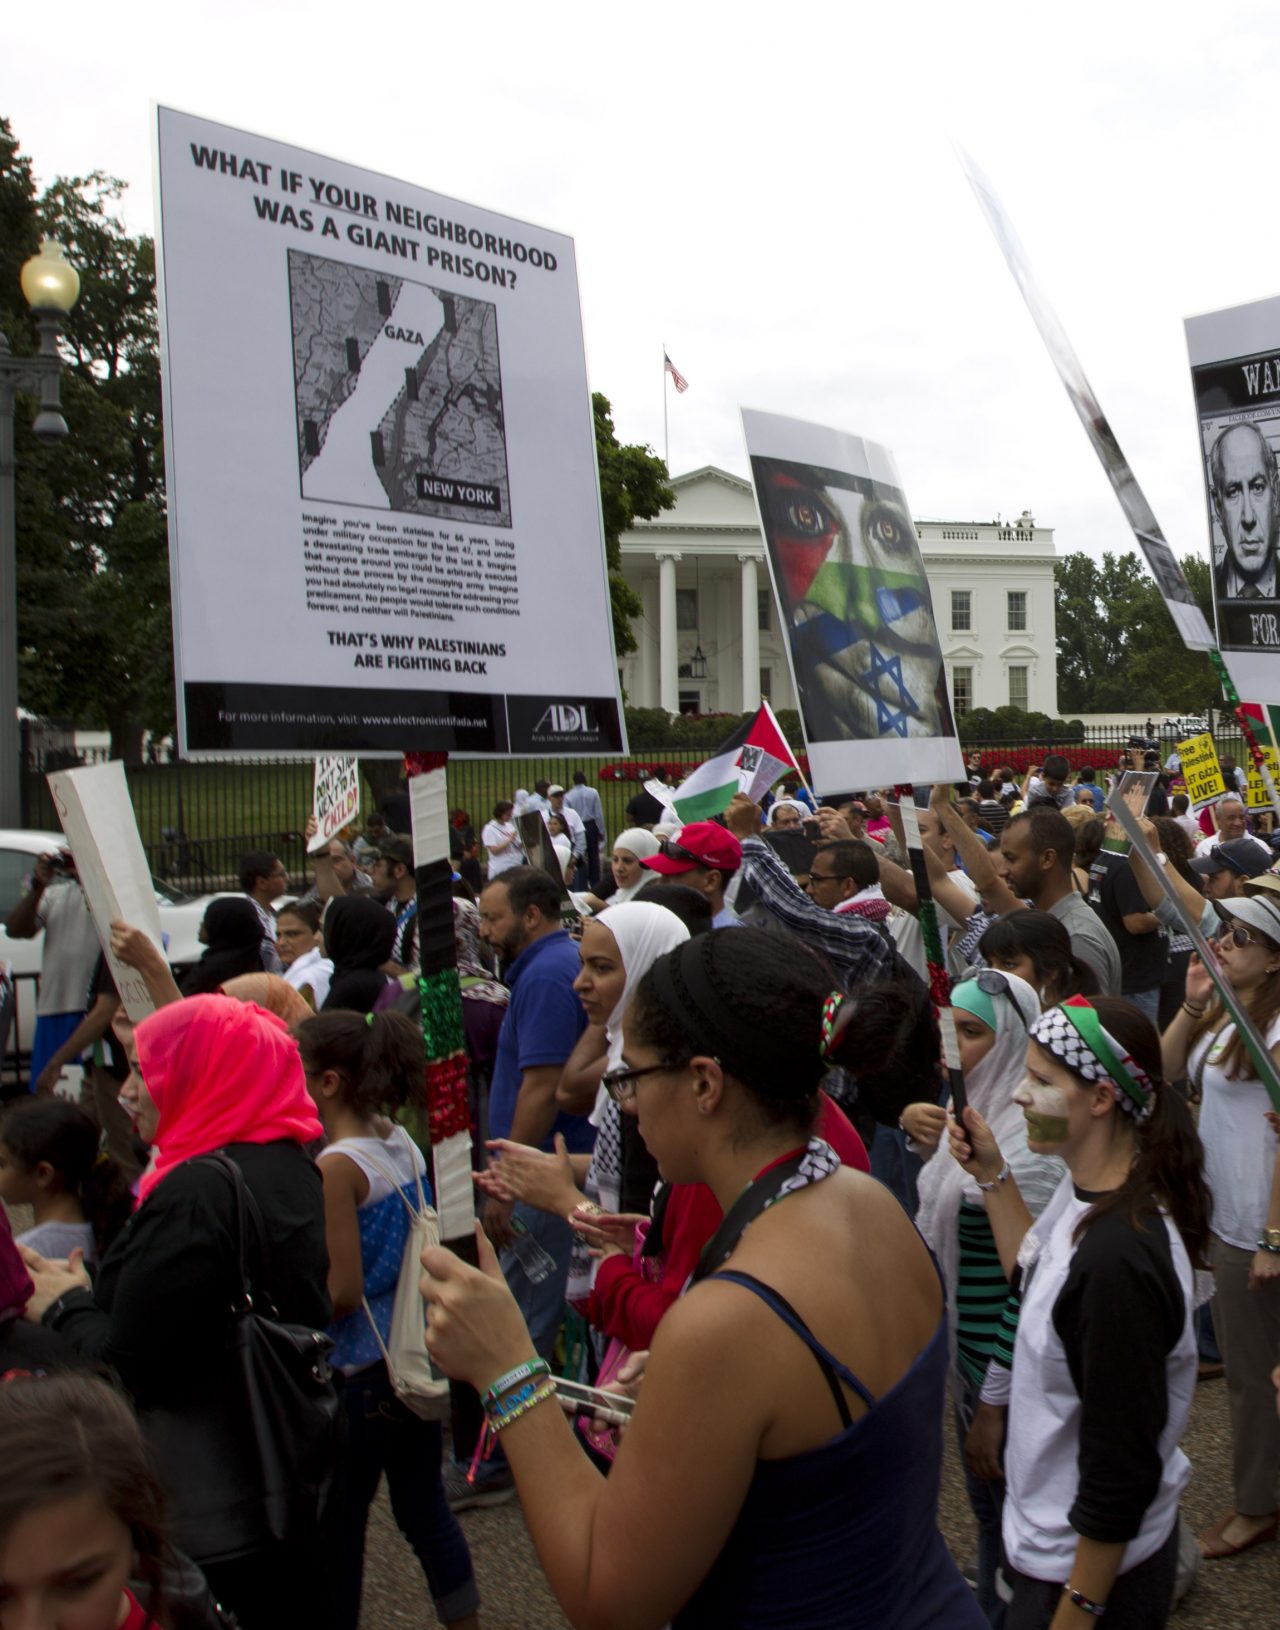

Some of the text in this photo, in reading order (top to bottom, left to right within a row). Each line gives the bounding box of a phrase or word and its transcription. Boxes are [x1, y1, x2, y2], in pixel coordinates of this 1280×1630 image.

[190, 142, 558, 272] WHAT IF YOUR NEIGHBORHOOD
[253, 195, 517, 290] WAS A GIANT PRISON?
[384, 324, 424, 346] GAZA
[423, 480, 495, 505] NEW YORK
[1249, 612, 1279, 646] FOR
[327, 631, 507, 657] THAT'S WHY PALESTINIANS
[354, 654, 487, 675] ARE FIGHTING BACK
[218, 710, 236, 723] For
[240, 712, 268, 723] more
[532, 704, 599, 733] ADL
[1199, 766, 1219, 781] GAZA
[1191, 779, 1219, 800] LIVE!
[324, 786, 358, 838] CHILD!
